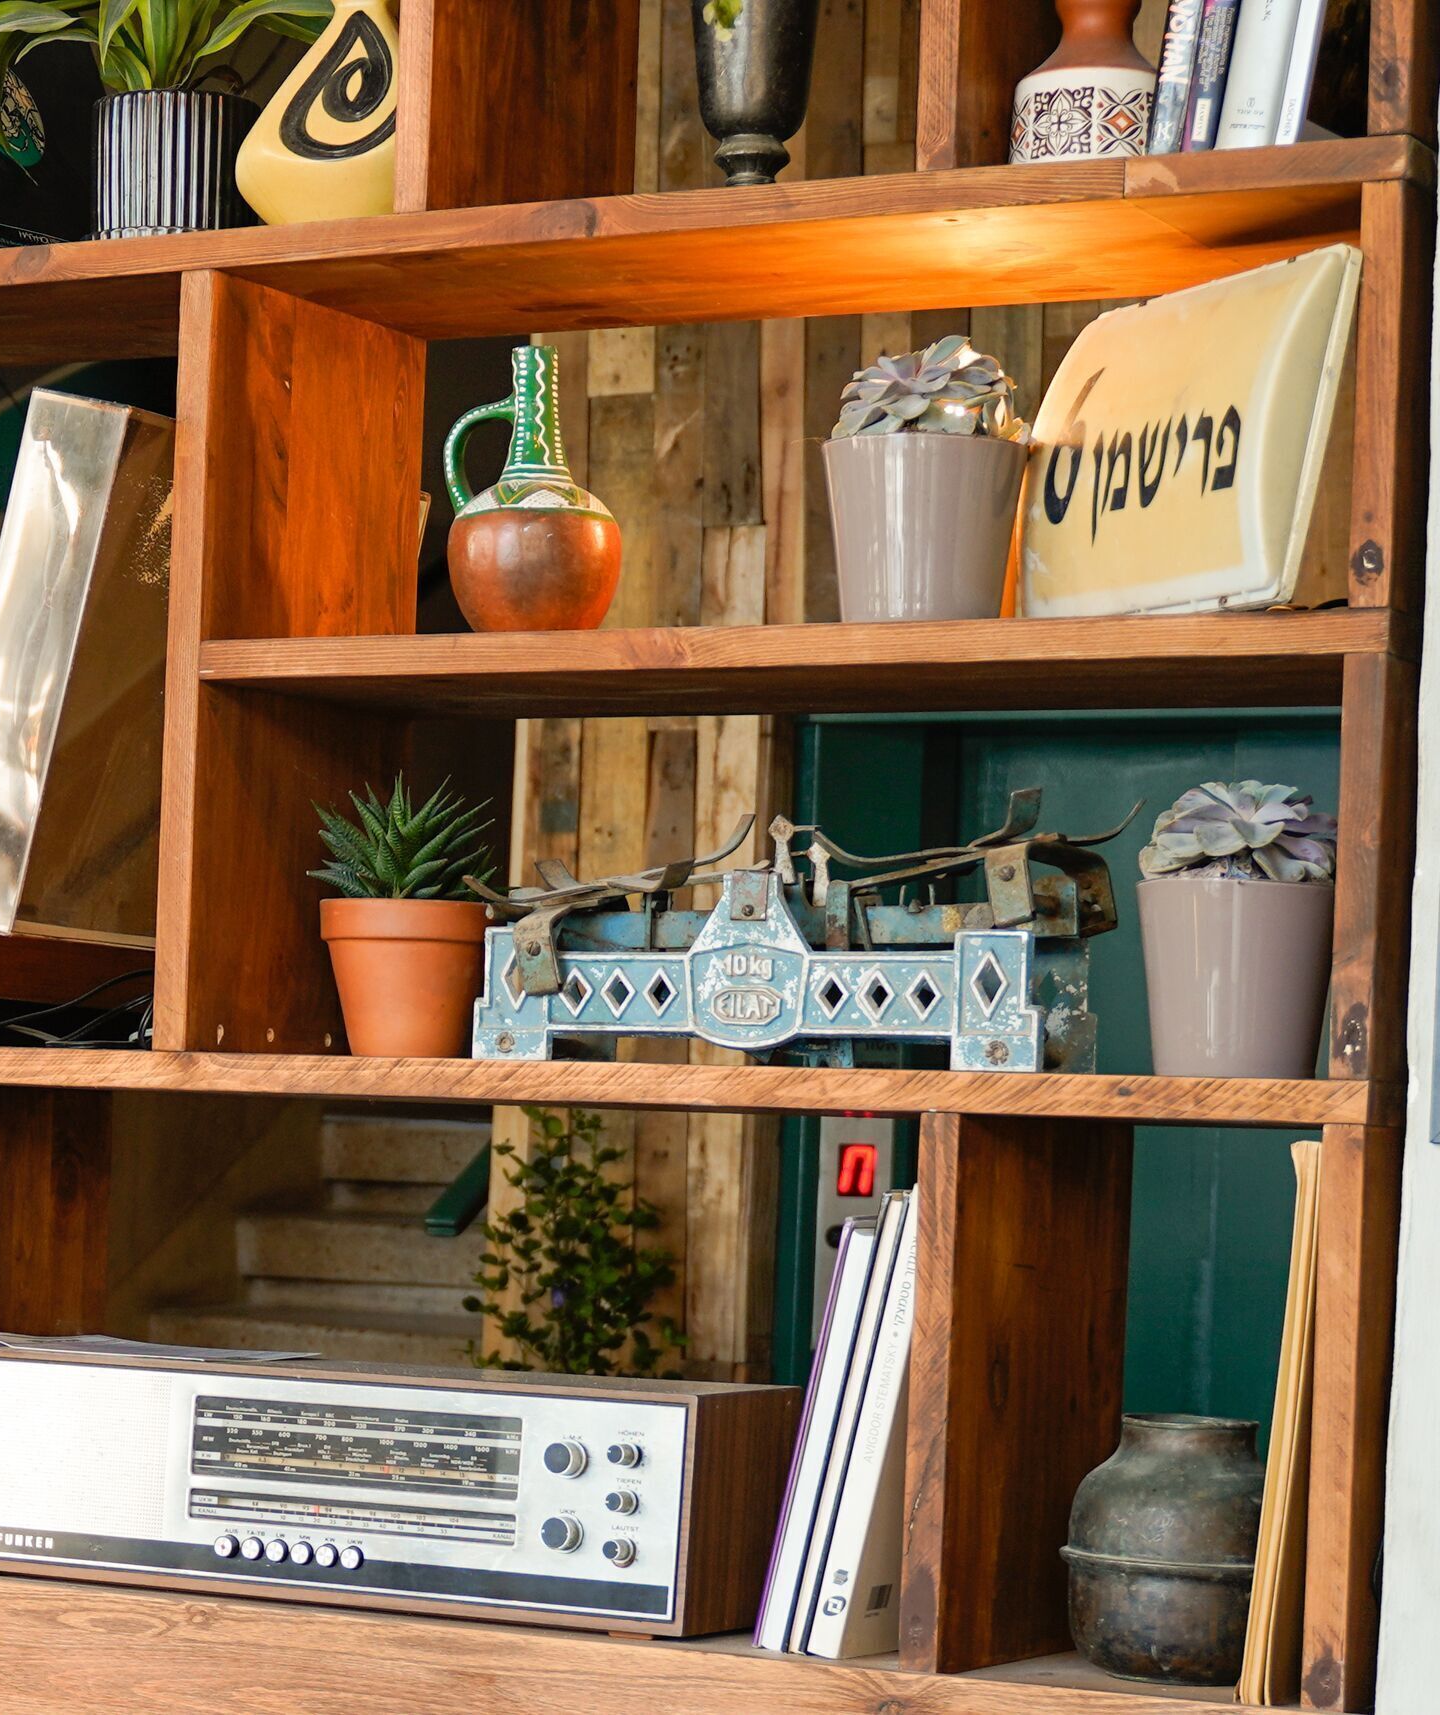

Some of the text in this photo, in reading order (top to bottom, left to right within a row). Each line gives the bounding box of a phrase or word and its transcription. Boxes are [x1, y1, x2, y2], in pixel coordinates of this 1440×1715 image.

[1282, 98, 1296, 136] TASCHEN
[1090, 404, 1241, 548] פרישמן
[716, 993, 776, 1019] EILAT
[893, 1281, 912, 1325] סטמצקי
[863, 1343, 897, 1463] AVIGDOR STEMATSKY
